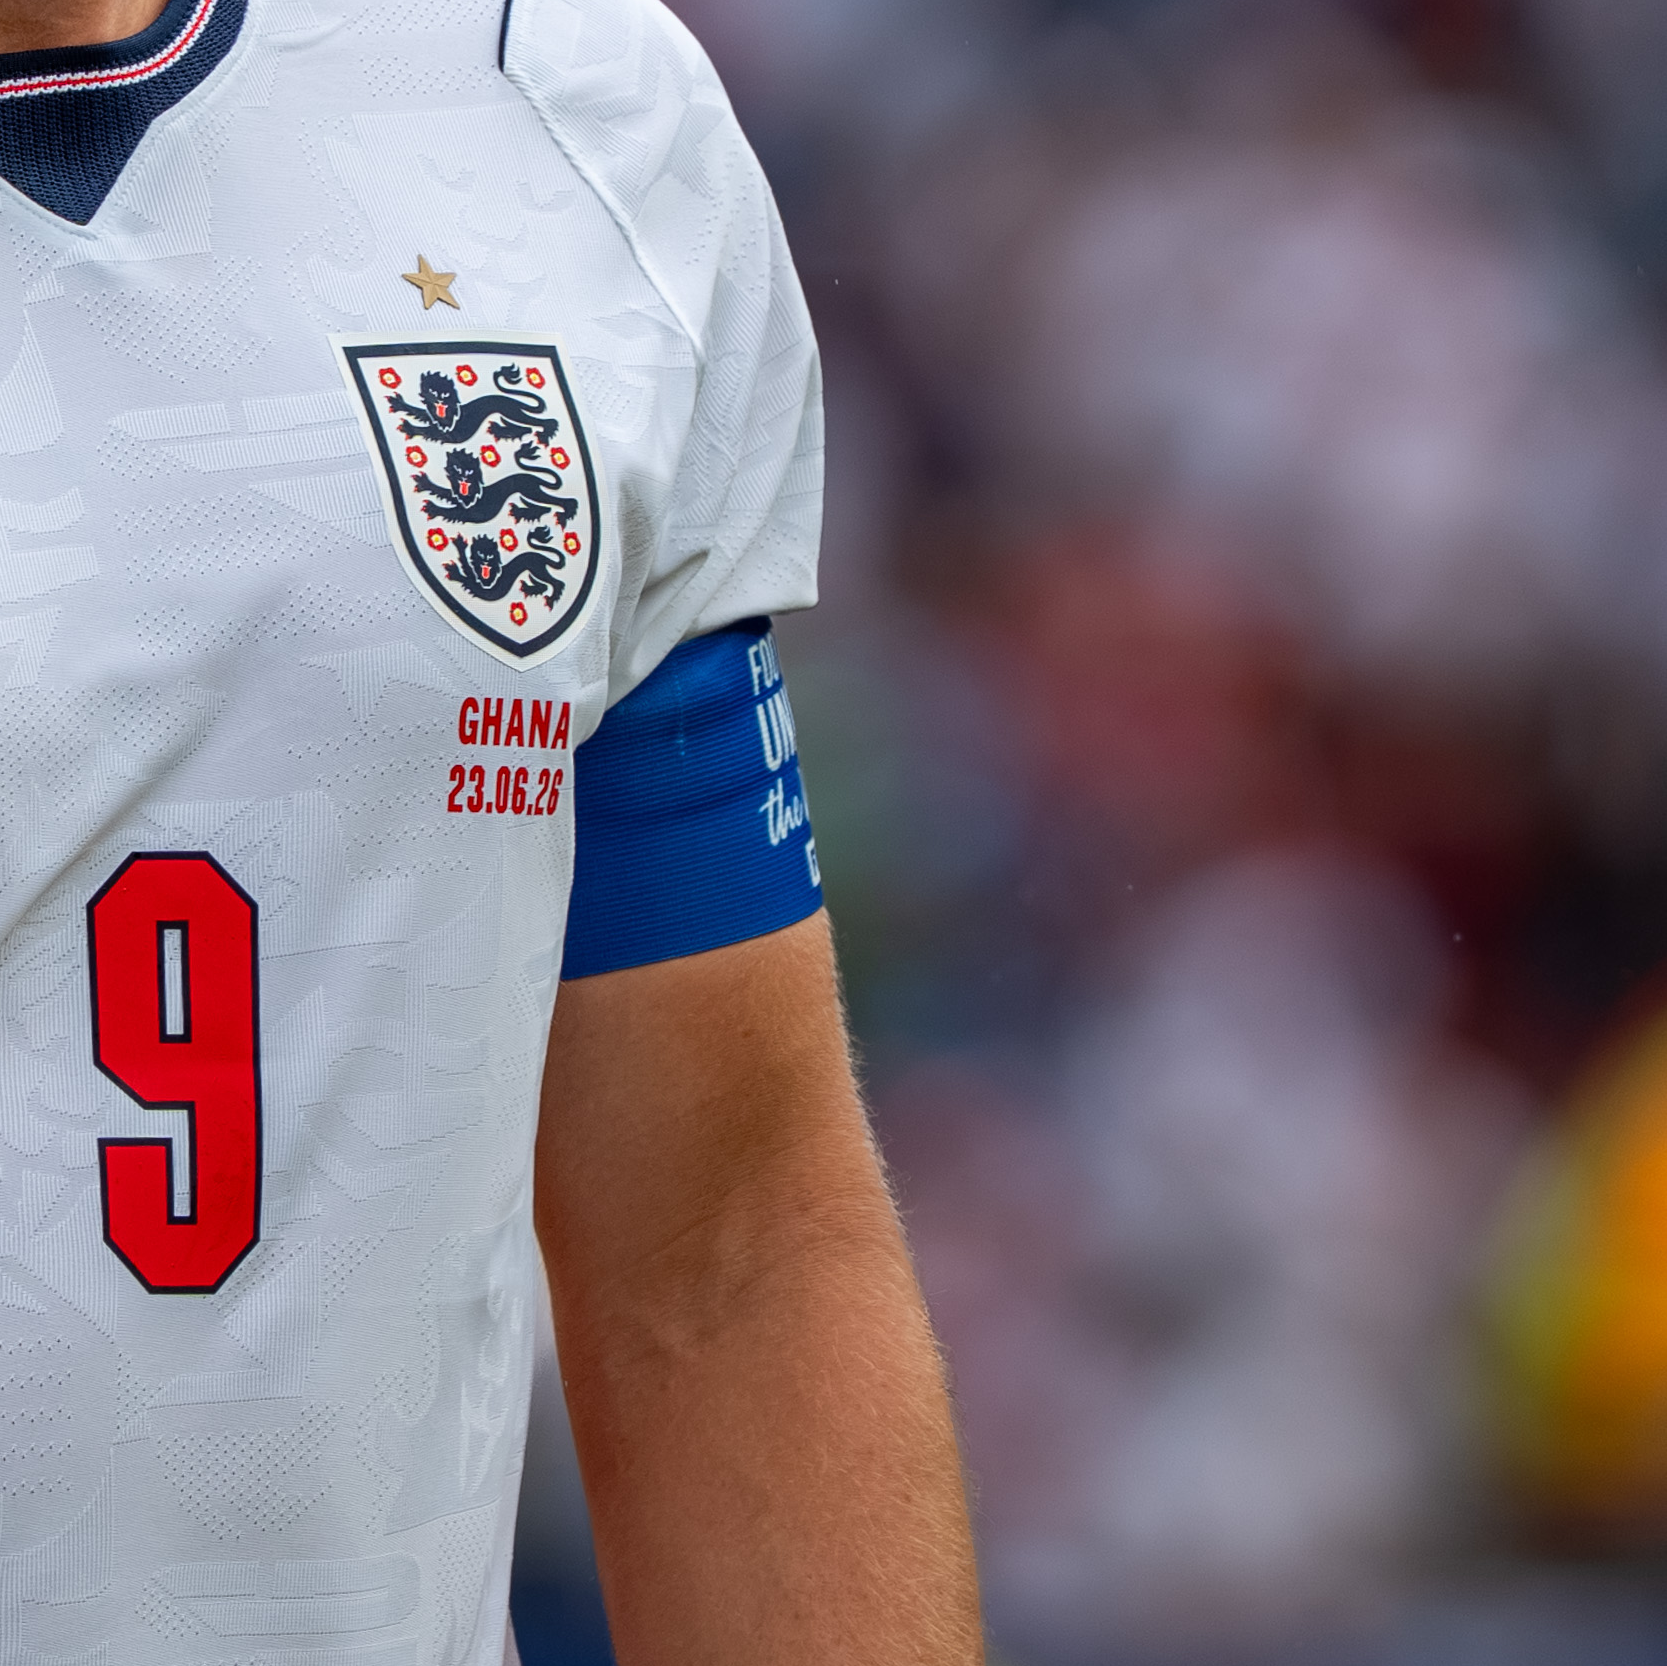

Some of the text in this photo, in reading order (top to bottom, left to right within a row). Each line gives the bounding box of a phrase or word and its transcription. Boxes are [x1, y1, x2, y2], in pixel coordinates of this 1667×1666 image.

[458, 696, 571, 750] GHANA
[447, 764, 564, 816] 23.06.26
[758, 777, 804, 846] the
[86, 851, 262, 1295] 9
